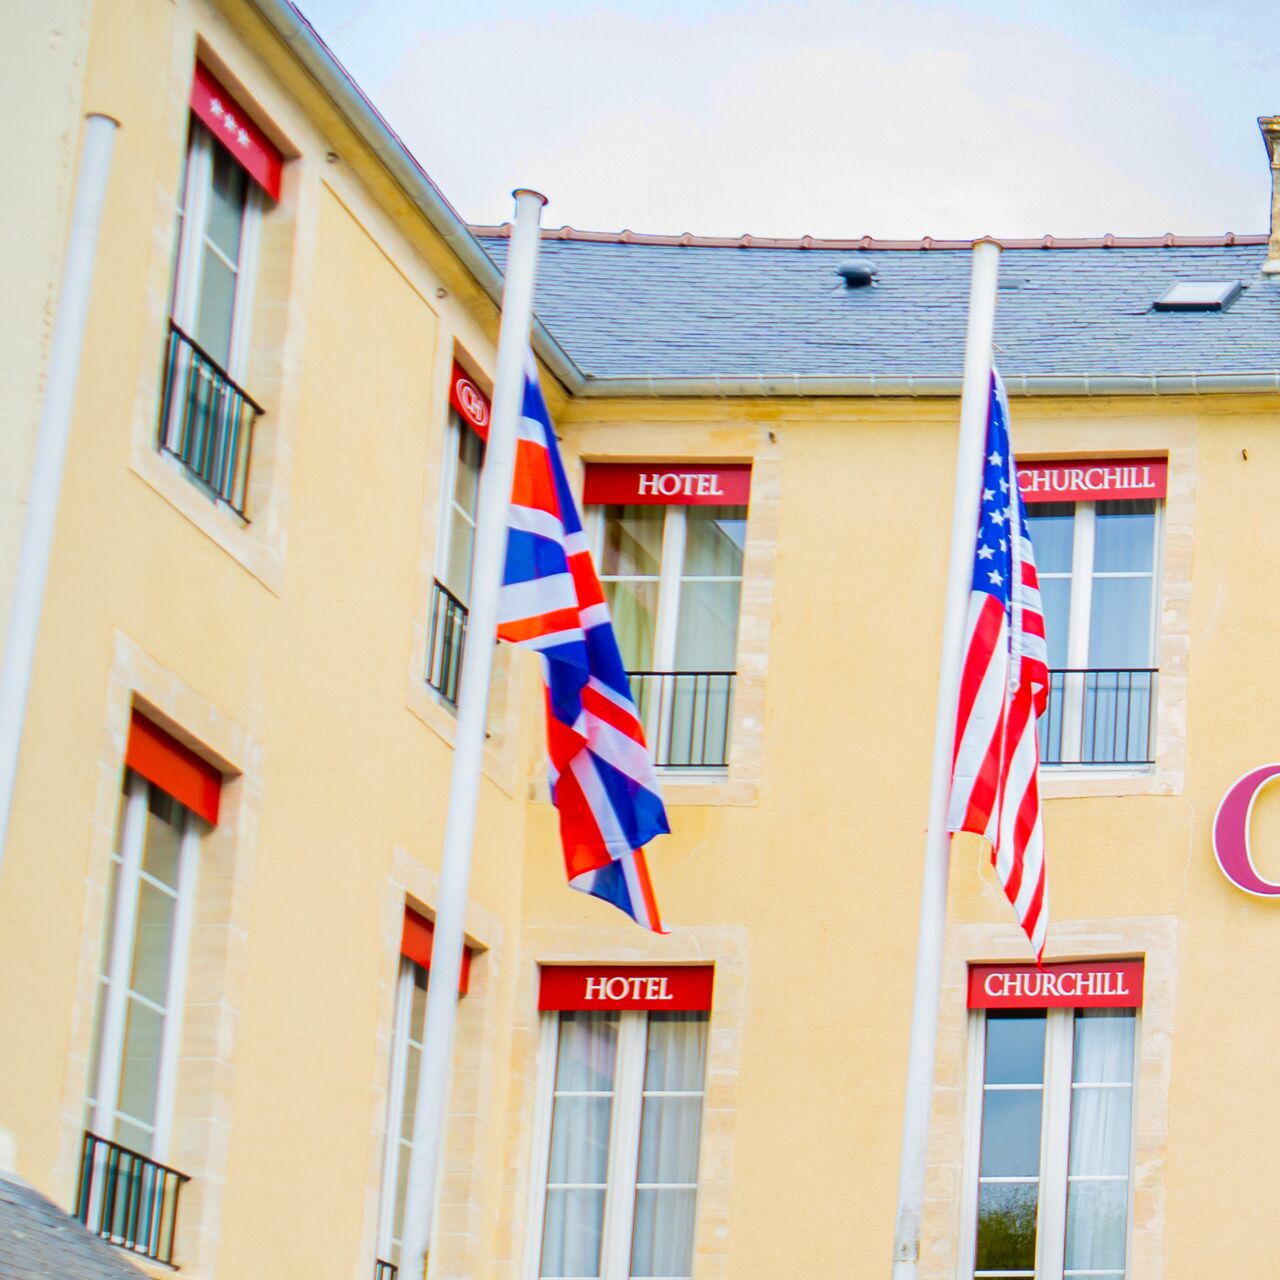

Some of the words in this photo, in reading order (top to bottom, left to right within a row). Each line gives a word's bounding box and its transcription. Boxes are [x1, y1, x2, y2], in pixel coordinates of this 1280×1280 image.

[638, 473, 724, 496] HOTEL
[1016, 466, 1155, 492] CHURCHILL
[584, 976, 673, 1000] HOTEL
[984, 972, 1129, 996] CHURCHILL
